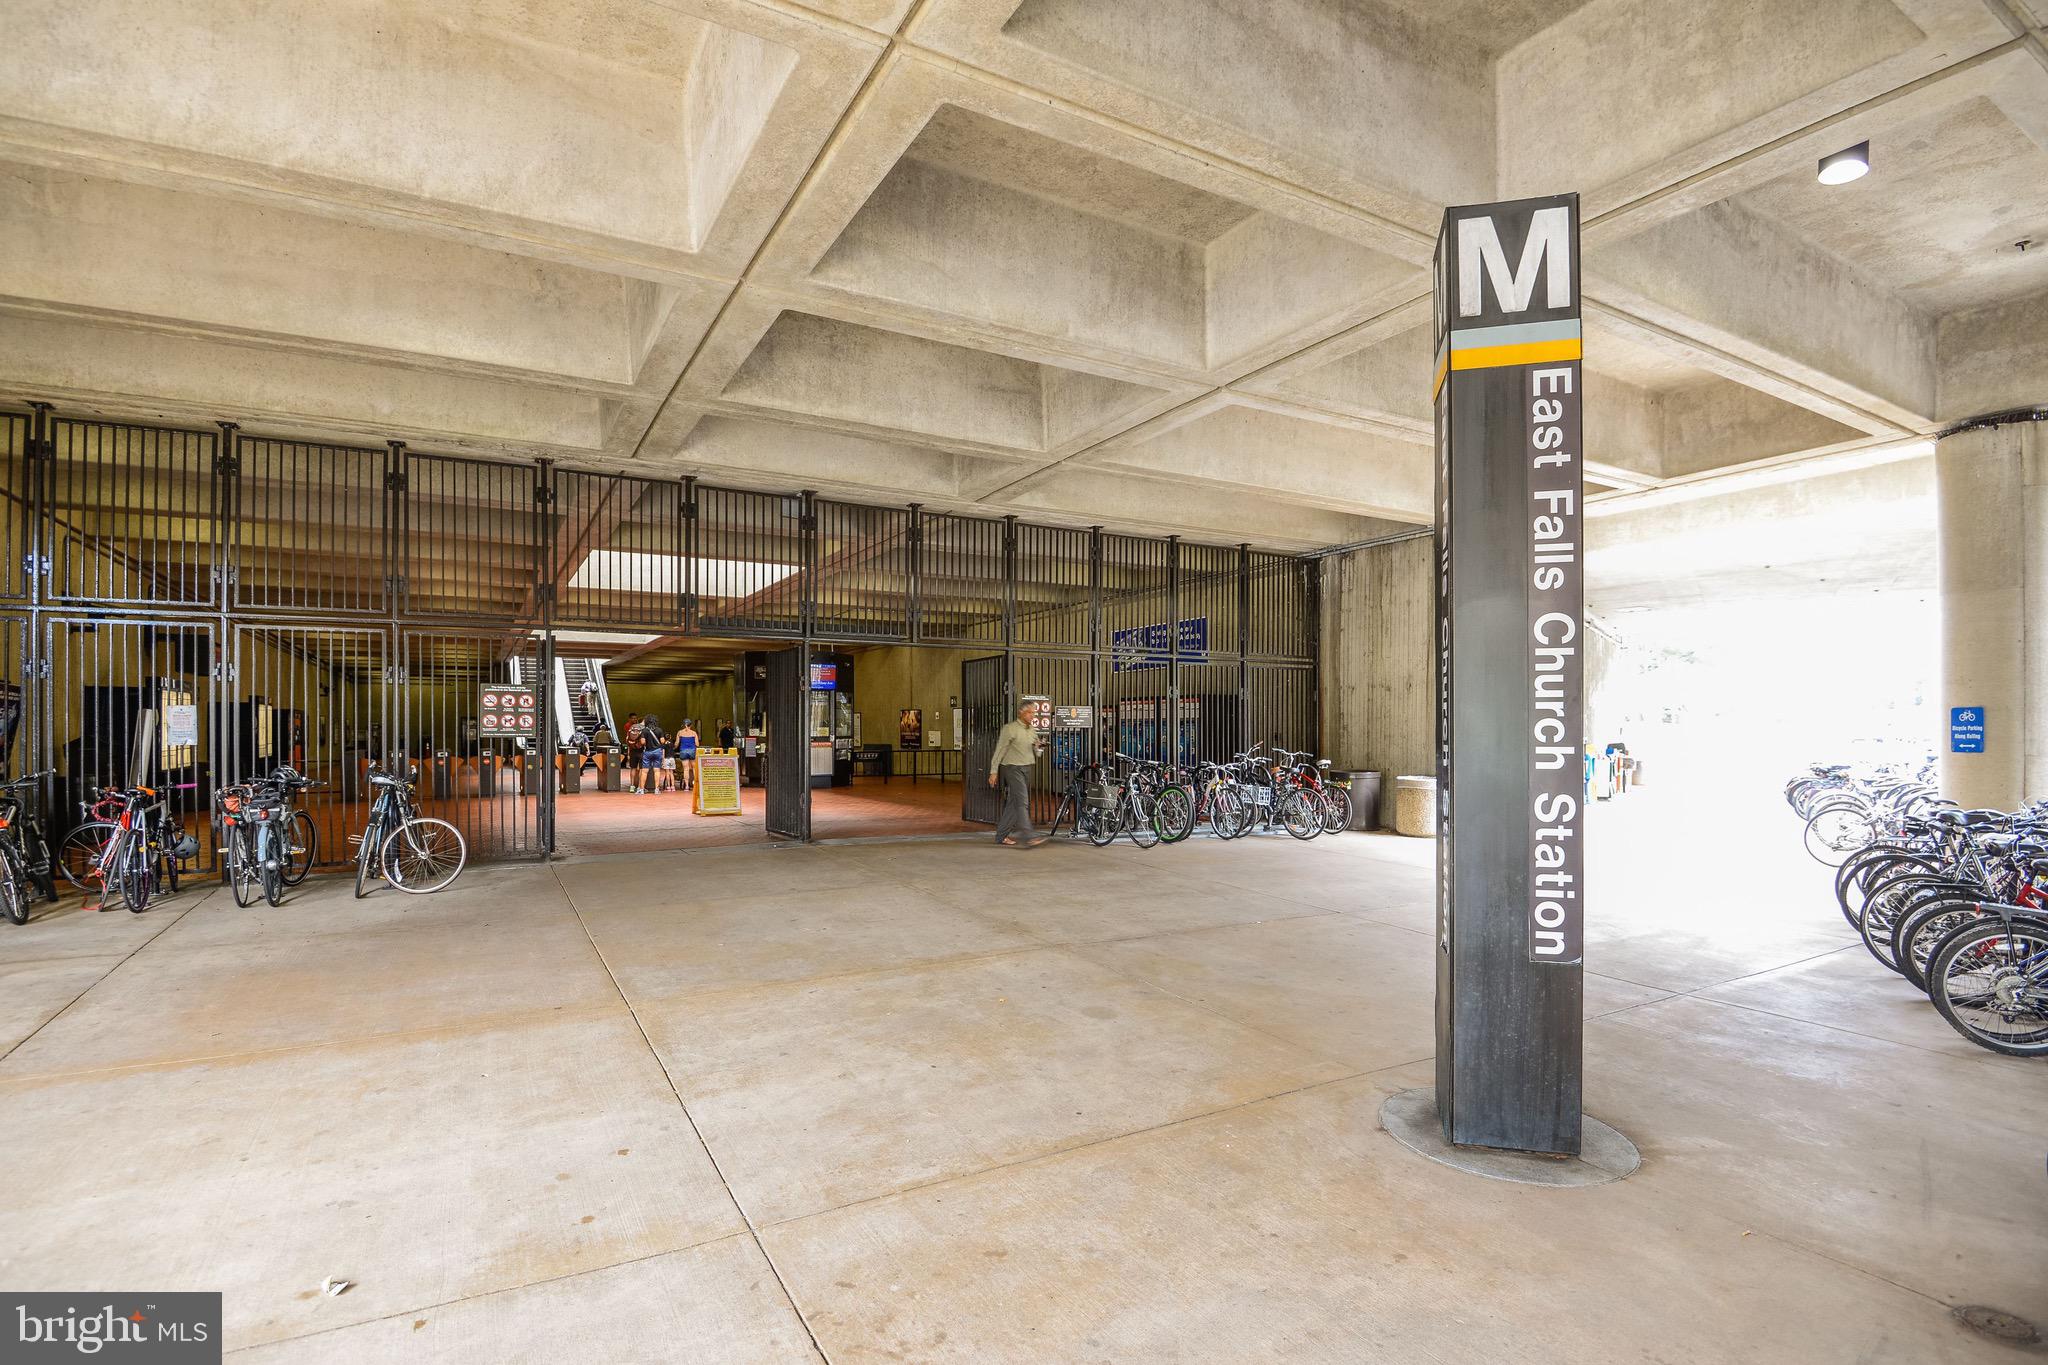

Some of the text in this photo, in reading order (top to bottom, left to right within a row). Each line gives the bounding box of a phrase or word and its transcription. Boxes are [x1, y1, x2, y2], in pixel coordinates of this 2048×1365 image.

[1458, 206, 1571, 317] M
[1441, 617, 1449, 768] Church
[1533, 368, 1576, 955] East Falls Church Station
